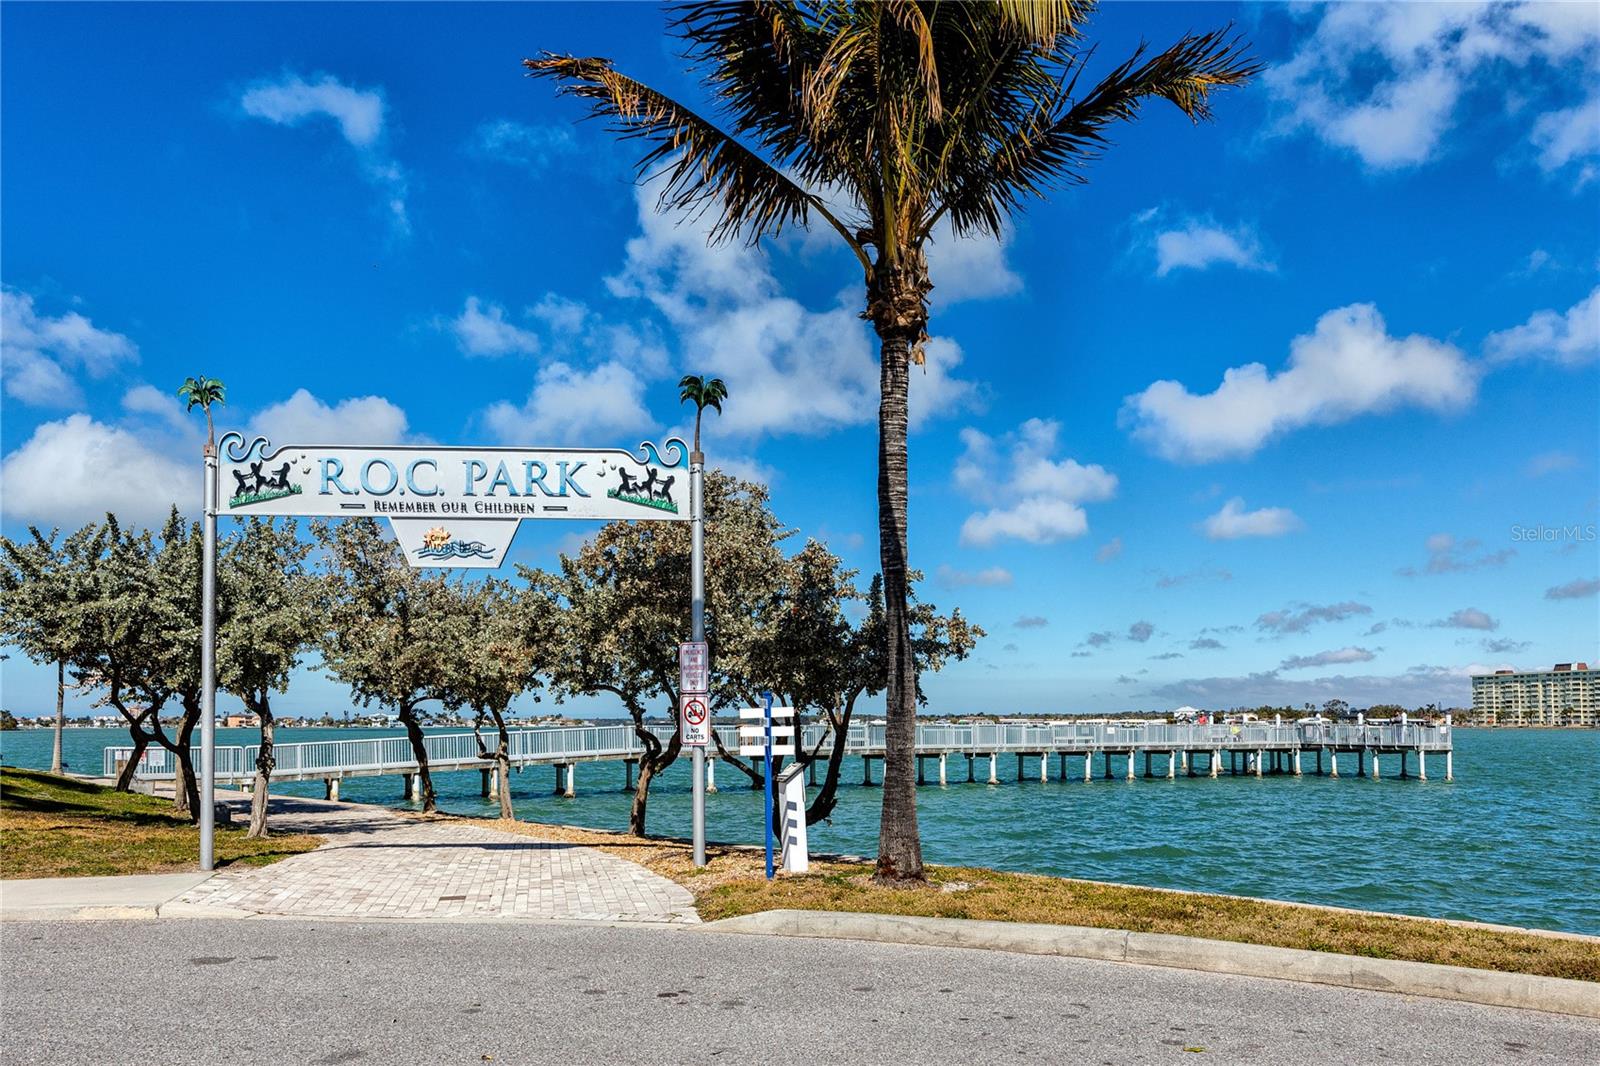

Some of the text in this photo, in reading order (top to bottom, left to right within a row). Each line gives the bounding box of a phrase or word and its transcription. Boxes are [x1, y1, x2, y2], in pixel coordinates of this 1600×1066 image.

[318, 457, 591, 498] R.O.C. PARK
[374, 500, 437, 513] REMEMBER
[474, 501, 535, 514] CHILDREN
